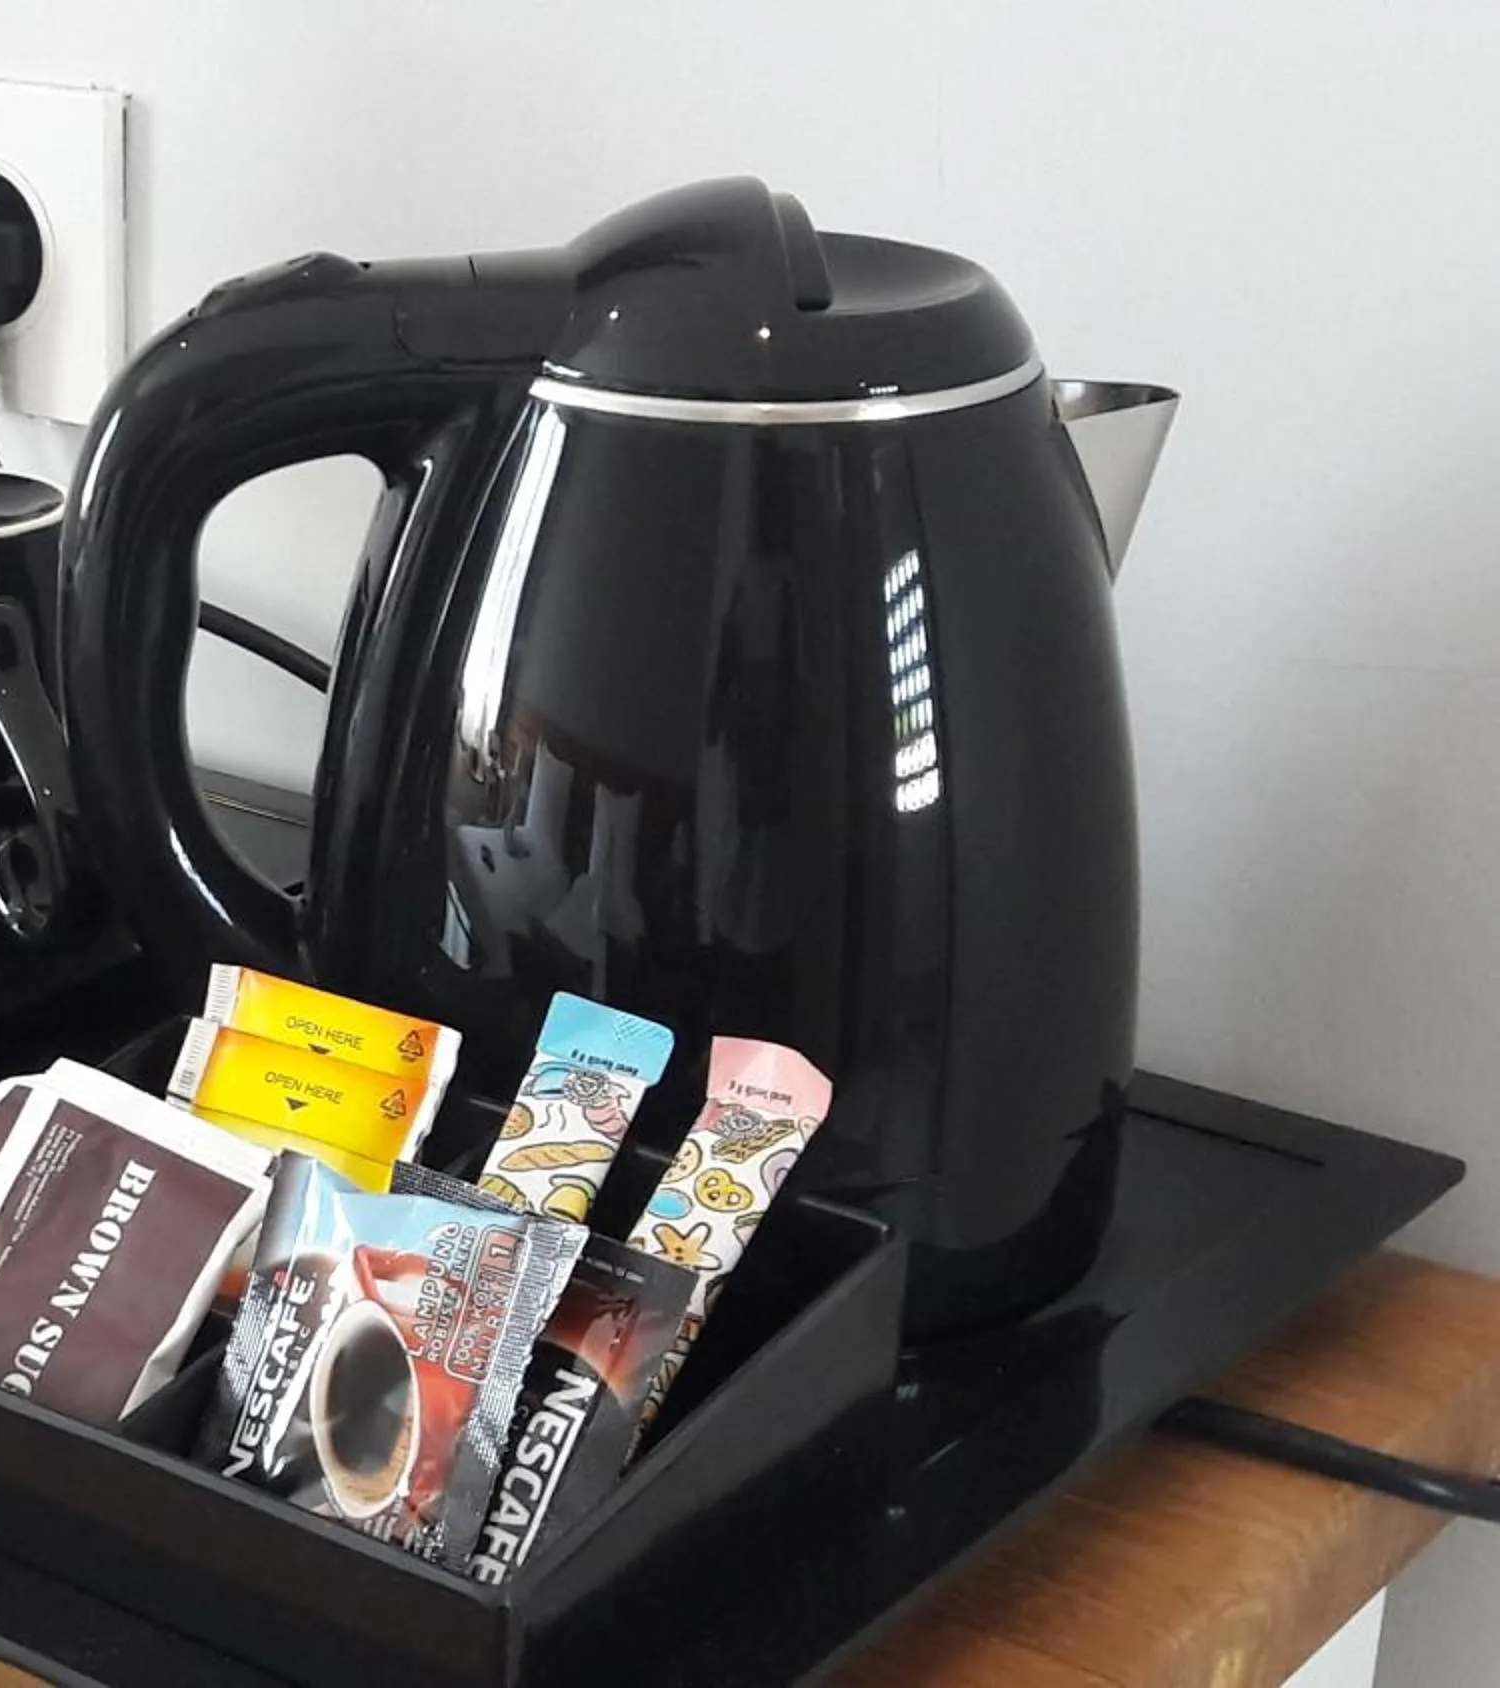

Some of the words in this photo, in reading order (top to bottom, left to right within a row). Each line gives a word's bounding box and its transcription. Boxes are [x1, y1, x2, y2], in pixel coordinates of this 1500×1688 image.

[286, 1016, 323, 1036] OPEN
[325, 1030, 364, 1050] HERE
[264, 1071, 302, 1091] OPEN
[304, 1083, 344, 1105] HERE
[50, 1159, 157, 1319] BROWN
[450, 1225, 477, 1279] BLEND
[490, 1244, 512, 1259] 1
